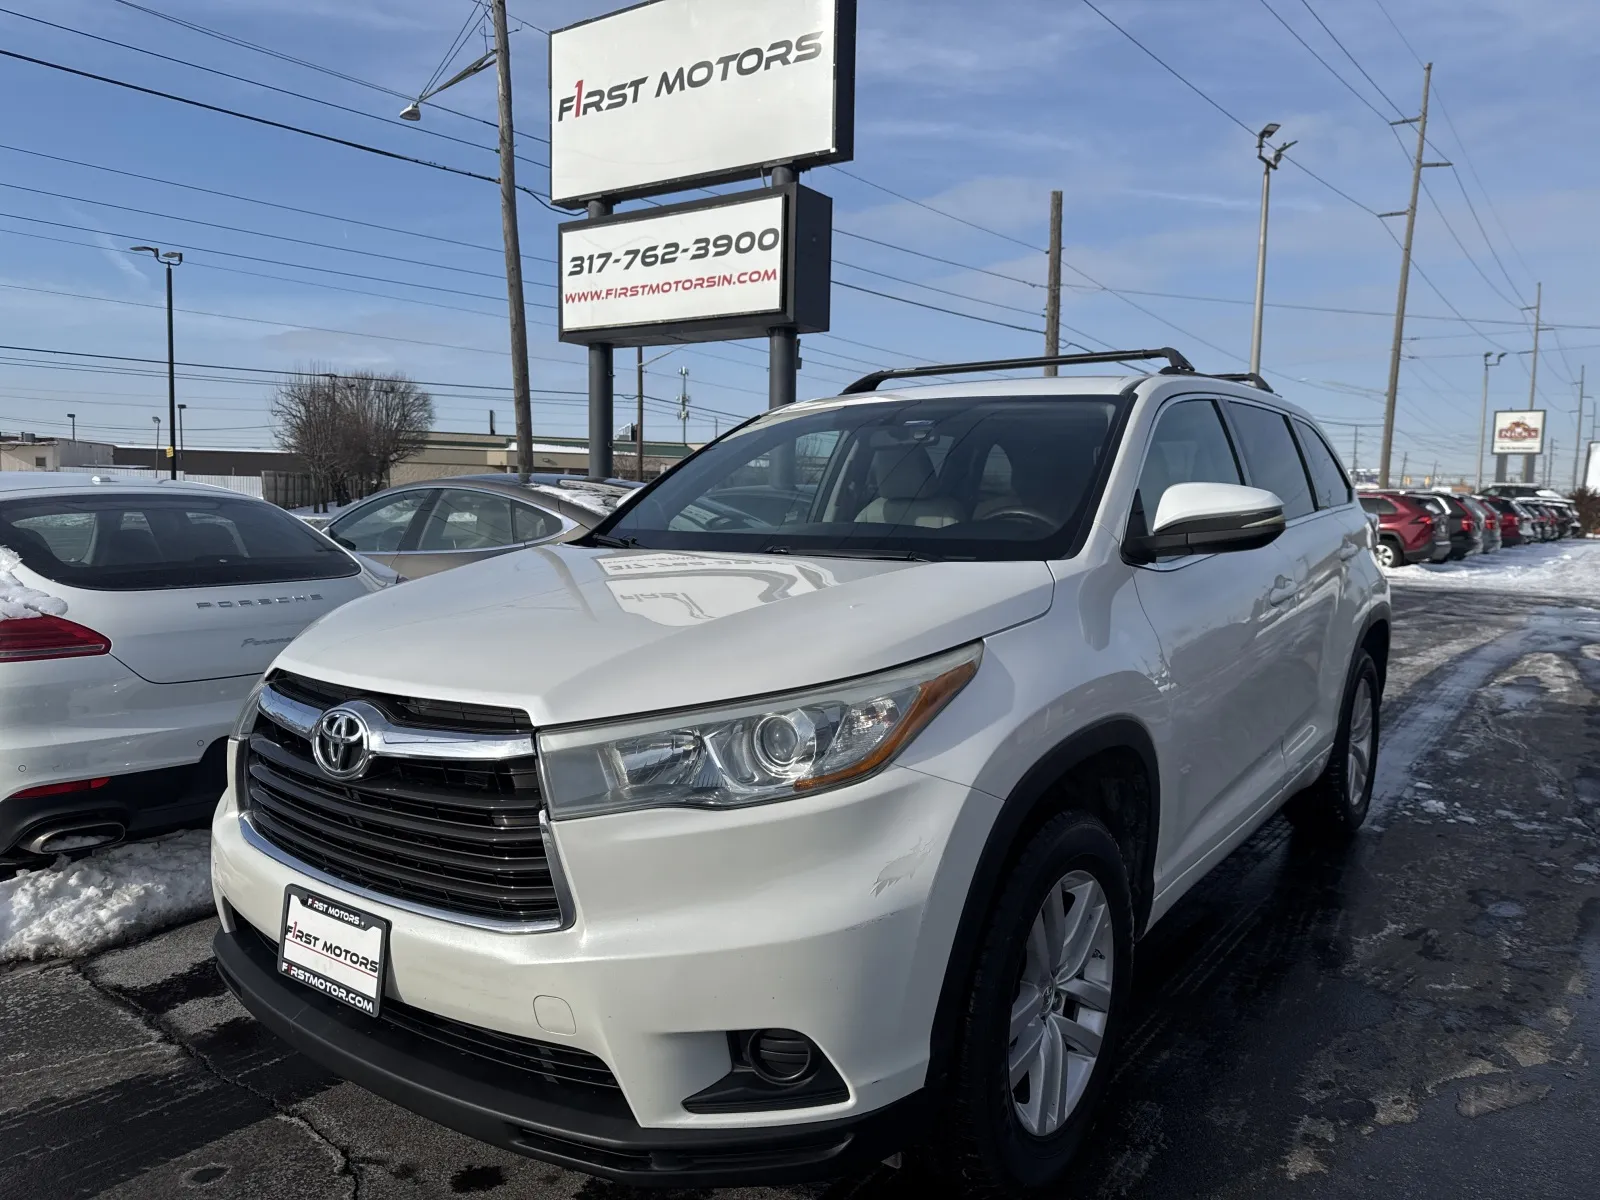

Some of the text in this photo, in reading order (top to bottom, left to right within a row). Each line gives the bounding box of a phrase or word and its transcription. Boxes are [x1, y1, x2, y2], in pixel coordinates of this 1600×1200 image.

[654, 30, 824, 99] MOTORS
[567, 227, 780, 277] 317-762-3900
[564, 268, 777, 304] WWW.FIRSTMOTORSIN.COM
[196, 593, 324, 609] PORSCHE
[327, 906, 360, 925] MOTORS
[321, 940, 379, 973] MOTORS
